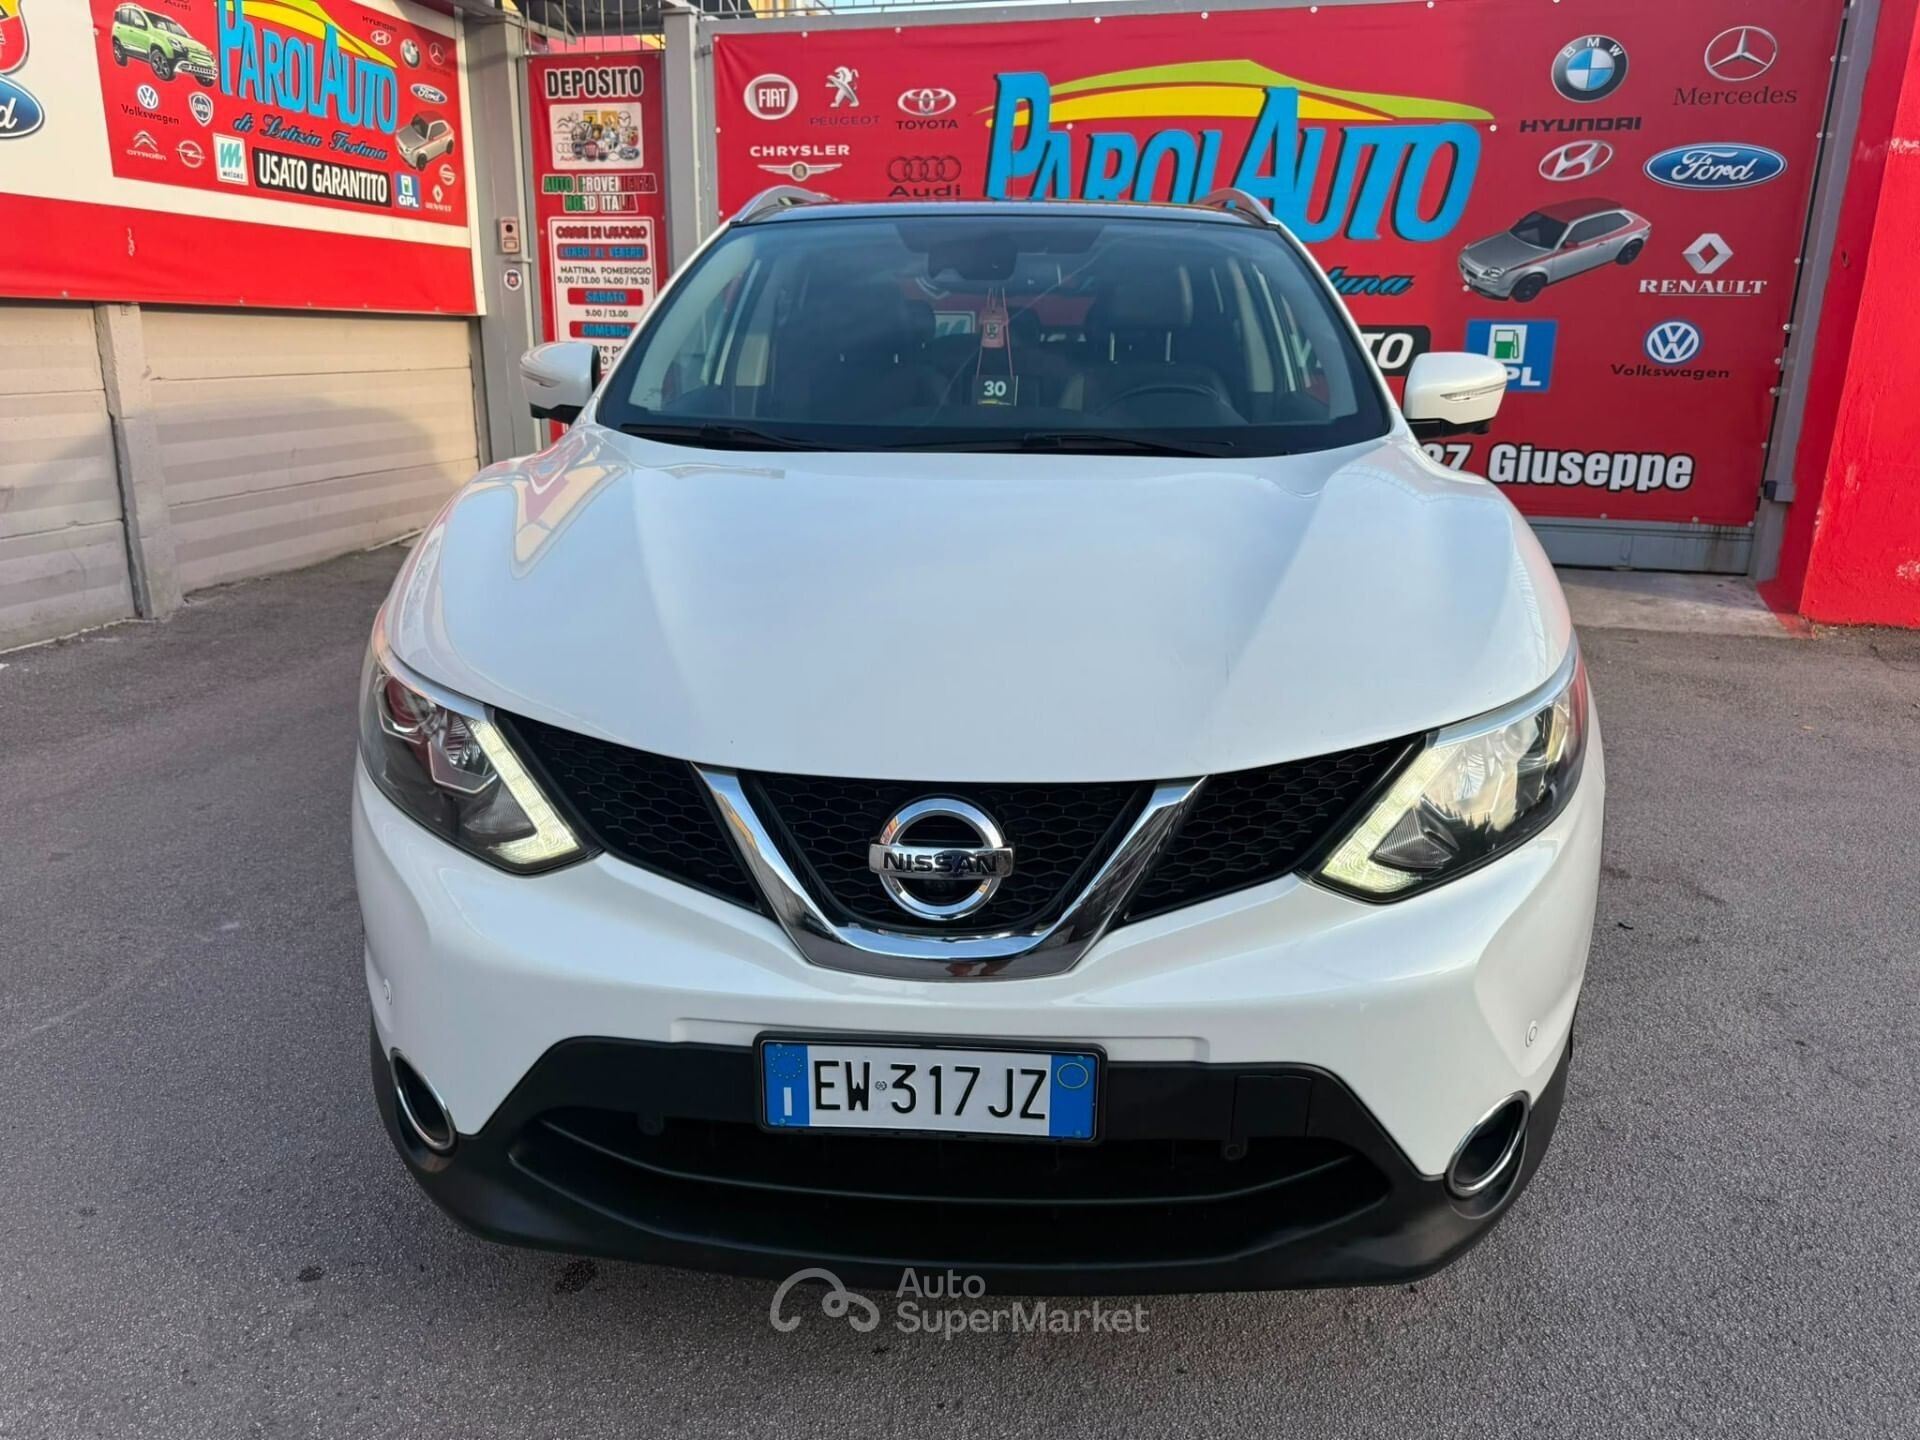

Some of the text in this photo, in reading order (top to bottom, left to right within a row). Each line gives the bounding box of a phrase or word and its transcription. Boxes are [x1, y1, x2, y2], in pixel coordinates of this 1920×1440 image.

[1562, 37, 1624, 59] BMW
[217, 0, 398, 134] PAROLAUTO
[546, 68, 643, 97] DEPOSITO
[758, 87, 788, 108] FIAT
[1672, 86, 1798, 106] Mercedes
[121, 104, 180, 125] Volkswagen
[809, 115, 881, 127] PEUGEOT
[1519, 116, 1642, 133] HYUNDAI
[896, 119, 959, 131] TOYOTA
[233, 113, 388, 160] di Letizia Fortuna
[750, 144, 851, 158] CHRYSLER
[984, 71, 1482, 242] PAROLAUTO
[1671, 150, 1758, 182] Ford
[258, 153, 388, 203] USATO GARANTITO
[398, 194, 419, 208] GPL
[887, 184, 962, 198] Audi
[560, 266, 652, 276] MATTINA POMERIGGIO
[1639, 278, 1768, 295] RENAULT
[1505, 366, 1541, 386] PL
[1610, 363, 1730, 380] Volkswagen
[983, 381, 1006, 396] 30
[1487, 441, 1694, 493] Giuseppe
[883, 852, 997, 874] NISSAN
